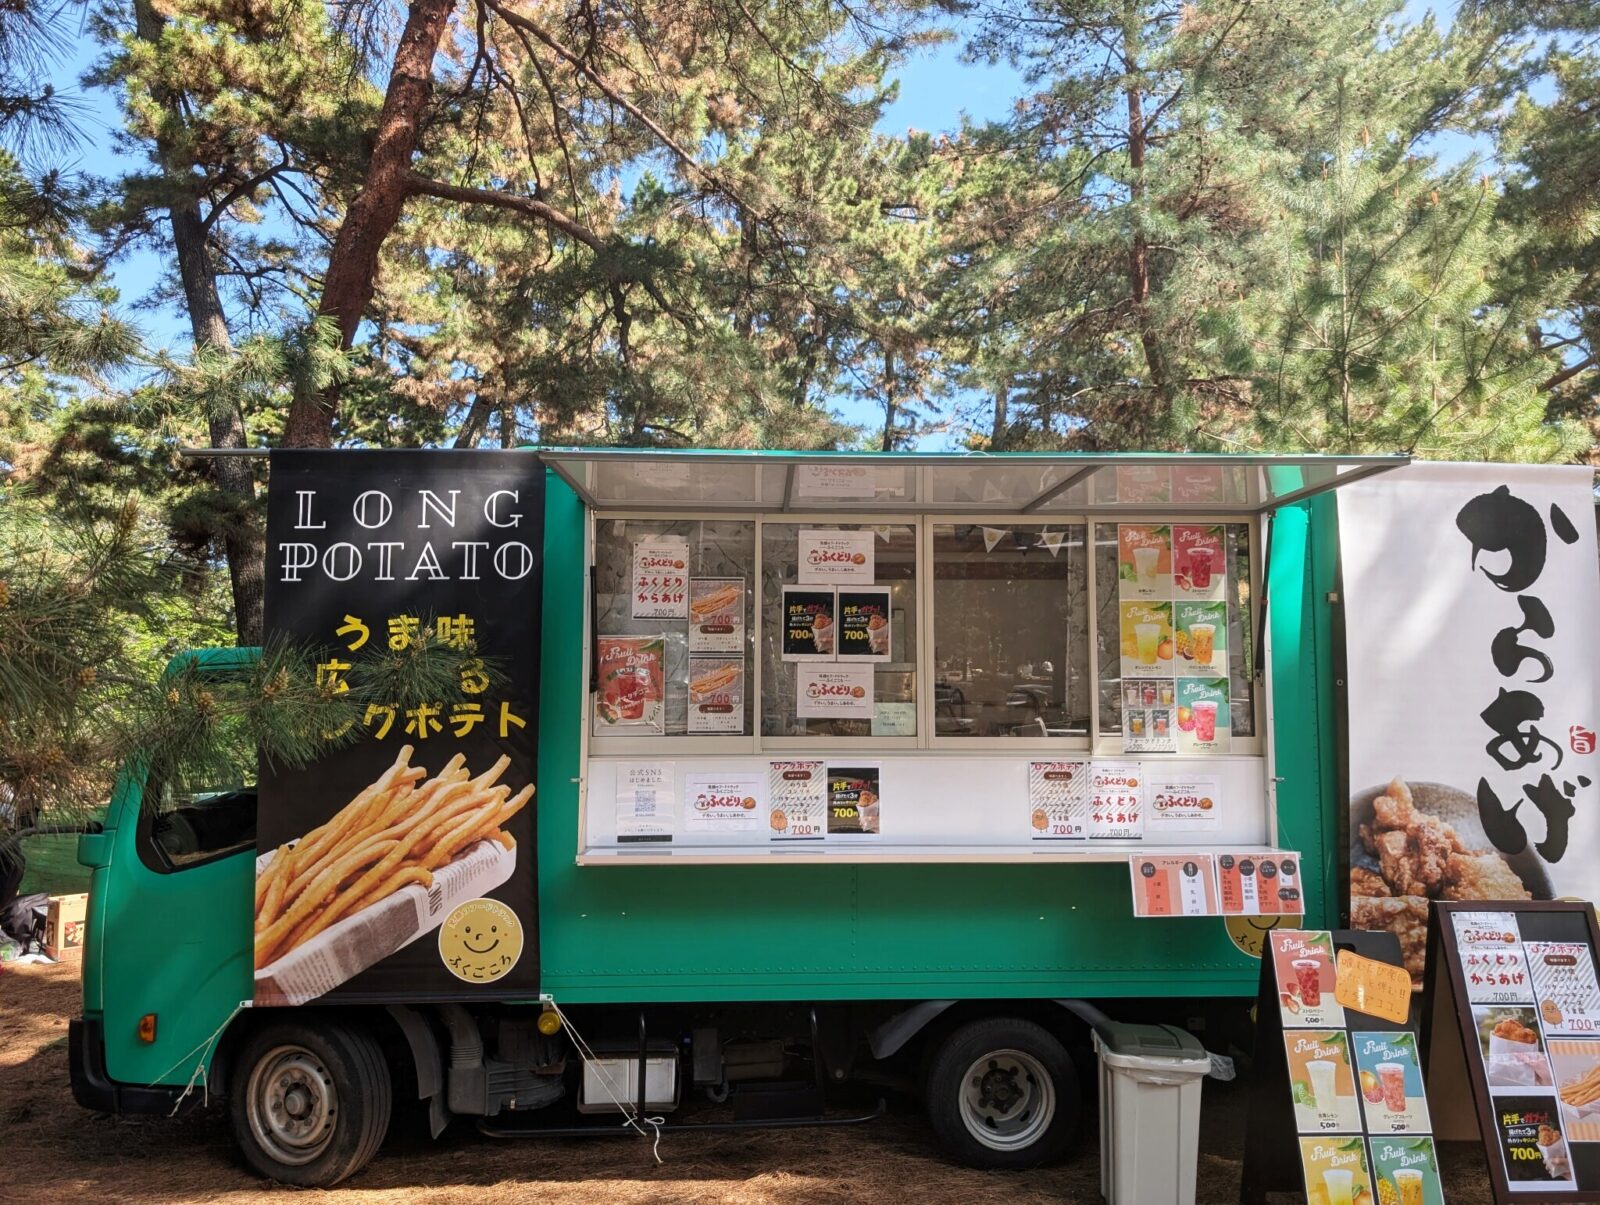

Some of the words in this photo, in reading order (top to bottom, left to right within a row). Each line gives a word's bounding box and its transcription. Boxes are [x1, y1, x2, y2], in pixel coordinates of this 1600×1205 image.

[293, 490, 524, 529] LONG
[1179, 530, 1201, 543] Fruit
[1195, 536, 1219, 547] Drink
[279, 541, 533, 582] POTATO
[638, 577, 683, 587] ふくどり
[653, 608, 675, 617] 700円
[1181, 607, 1202, 618] Fruit
[1196, 612, 1221, 623] Drink
[336, 613, 475, 651] うま味
[789, 629, 814, 640] 700円
[844, 630, 869, 640] 700円
[1455, 484, 1592, 864] からあげ
[1183, 683, 1206, 695] Fruit
[1199, 689, 1222, 699] Drink
[1093, 796, 1137, 806] ふくどり
[833, 808, 858, 818] 700円
[791, 825, 821, 834] 700円
[1052, 825, 1082, 834] 700円
[1110, 828, 1130, 837] 700円
[1280, 938, 1305, 952] Fruit
[1299, 945, 1325, 958] Drink
[449, 954, 512, 979] ふくごころ
[1493, 992, 1518, 1001] 700円
[1294, 1038, 1320, 1054] Fruit
[1314, 1045, 1341, 1059] Drink
[1363, 1040, 1388, 1055] Fruit
[1382, 1047, 1410, 1061] Drink
[1310, 1145, 1337, 1161] Fruit
[1330, 1152, 1359, 1167] Drink
[1380, 1145, 1407, 1161] Fruit
[1400, 1152, 1428, 1167] Drink
[1510, 1147, 1542, 1160] 700円
